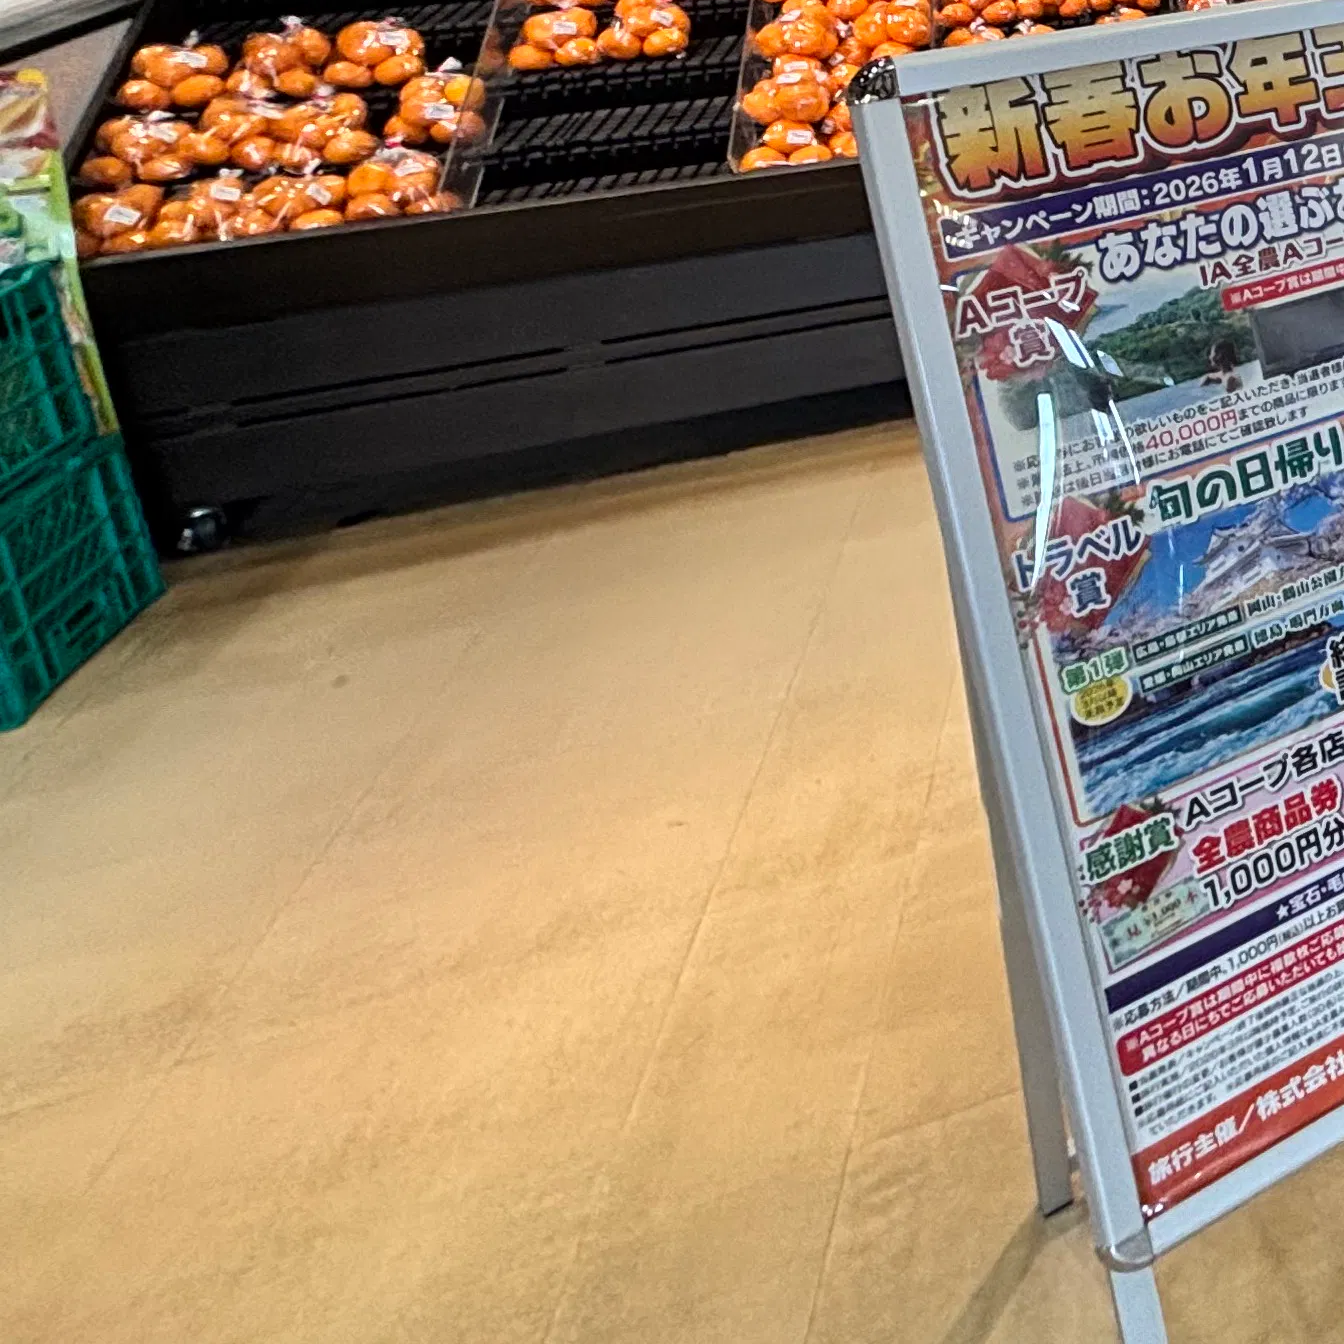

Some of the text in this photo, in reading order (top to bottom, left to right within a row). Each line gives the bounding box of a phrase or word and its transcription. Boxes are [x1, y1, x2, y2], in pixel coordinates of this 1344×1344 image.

[951, 269, 1094, 335] Aコープ
[1010, 317, 1054, 366] 賞
[1011, 512, 1144, 593] トラベル
[1068, 567, 1111, 617] 賞
[1060, 645, 1130, 693] 第1弾
[1083, 814, 1175, 884] 感謝賞
[1190, 775, 1341, 874] 全農商品券
